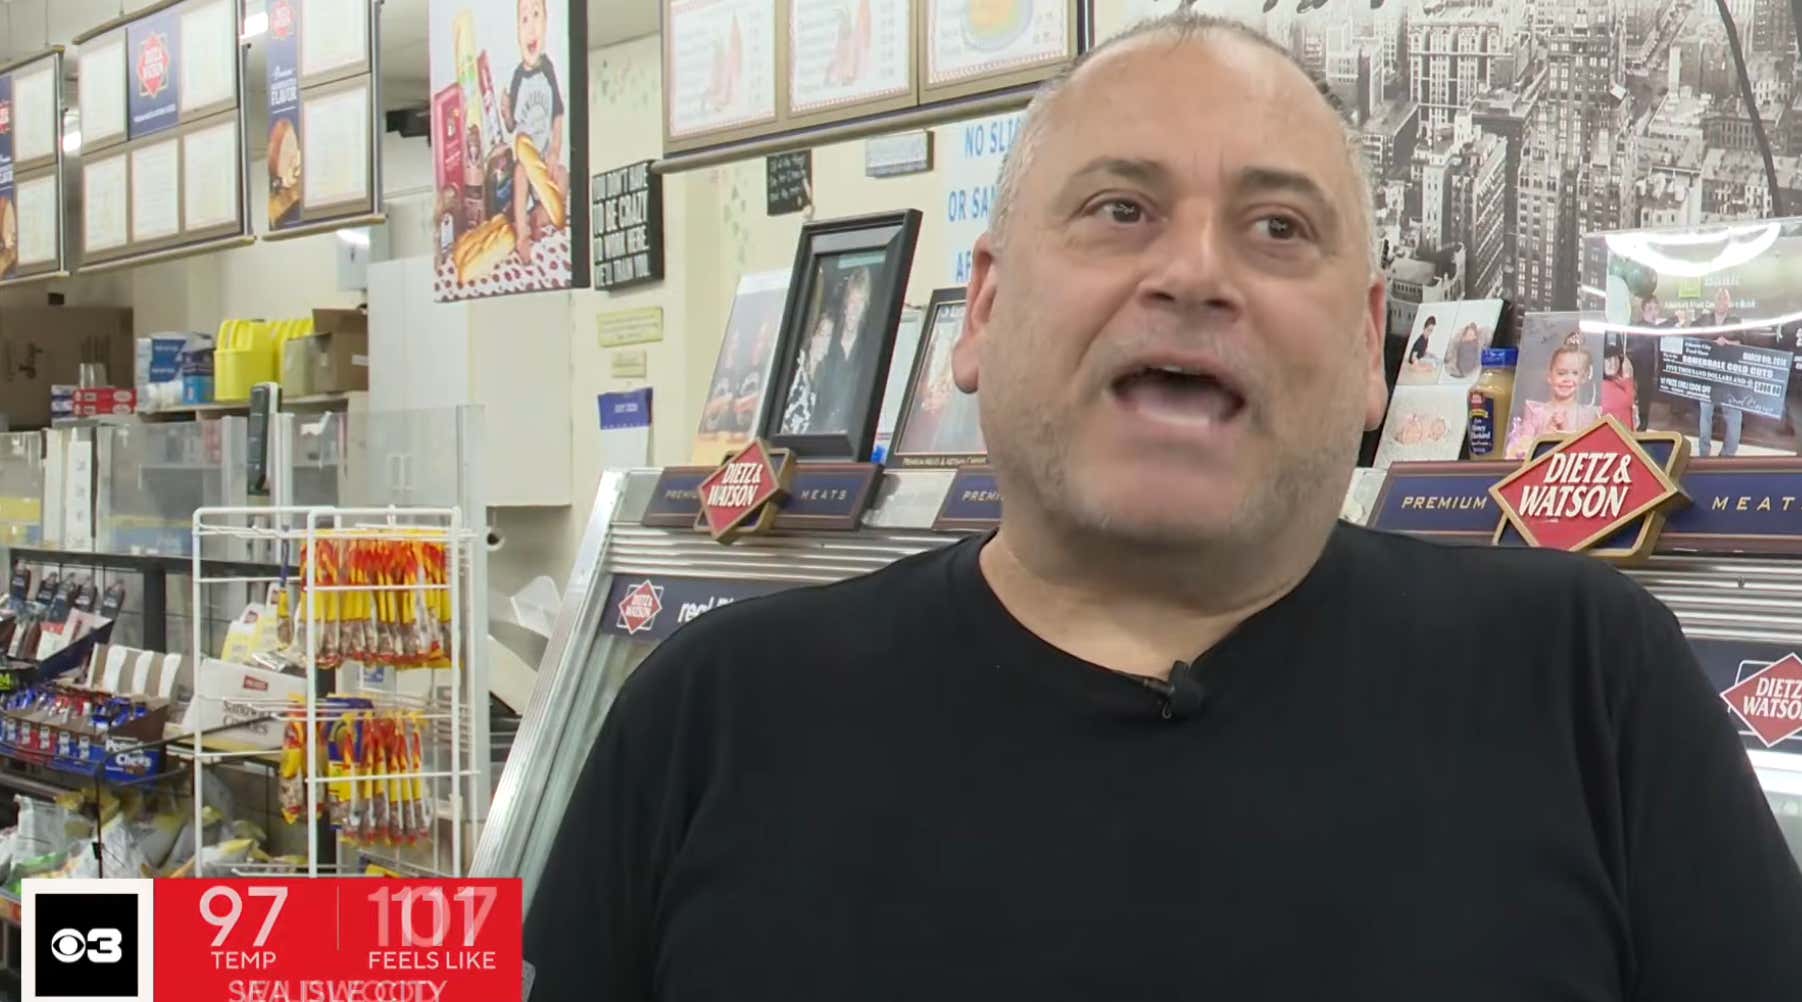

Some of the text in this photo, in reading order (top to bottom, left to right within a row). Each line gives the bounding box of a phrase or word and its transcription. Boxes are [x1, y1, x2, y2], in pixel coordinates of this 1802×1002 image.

[965, 124, 984, 157] NO
[948, 189, 967, 223] OR
[955, 250, 971, 282] AF
[708, 485, 759, 507] WATSON
[801, 489, 848, 501] MEATS
[1401, 496, 1488, 511] PREMIUM
[1519, 485, 1629, 519] WATSON
[1743, 695, 1802, 720] WATSO
